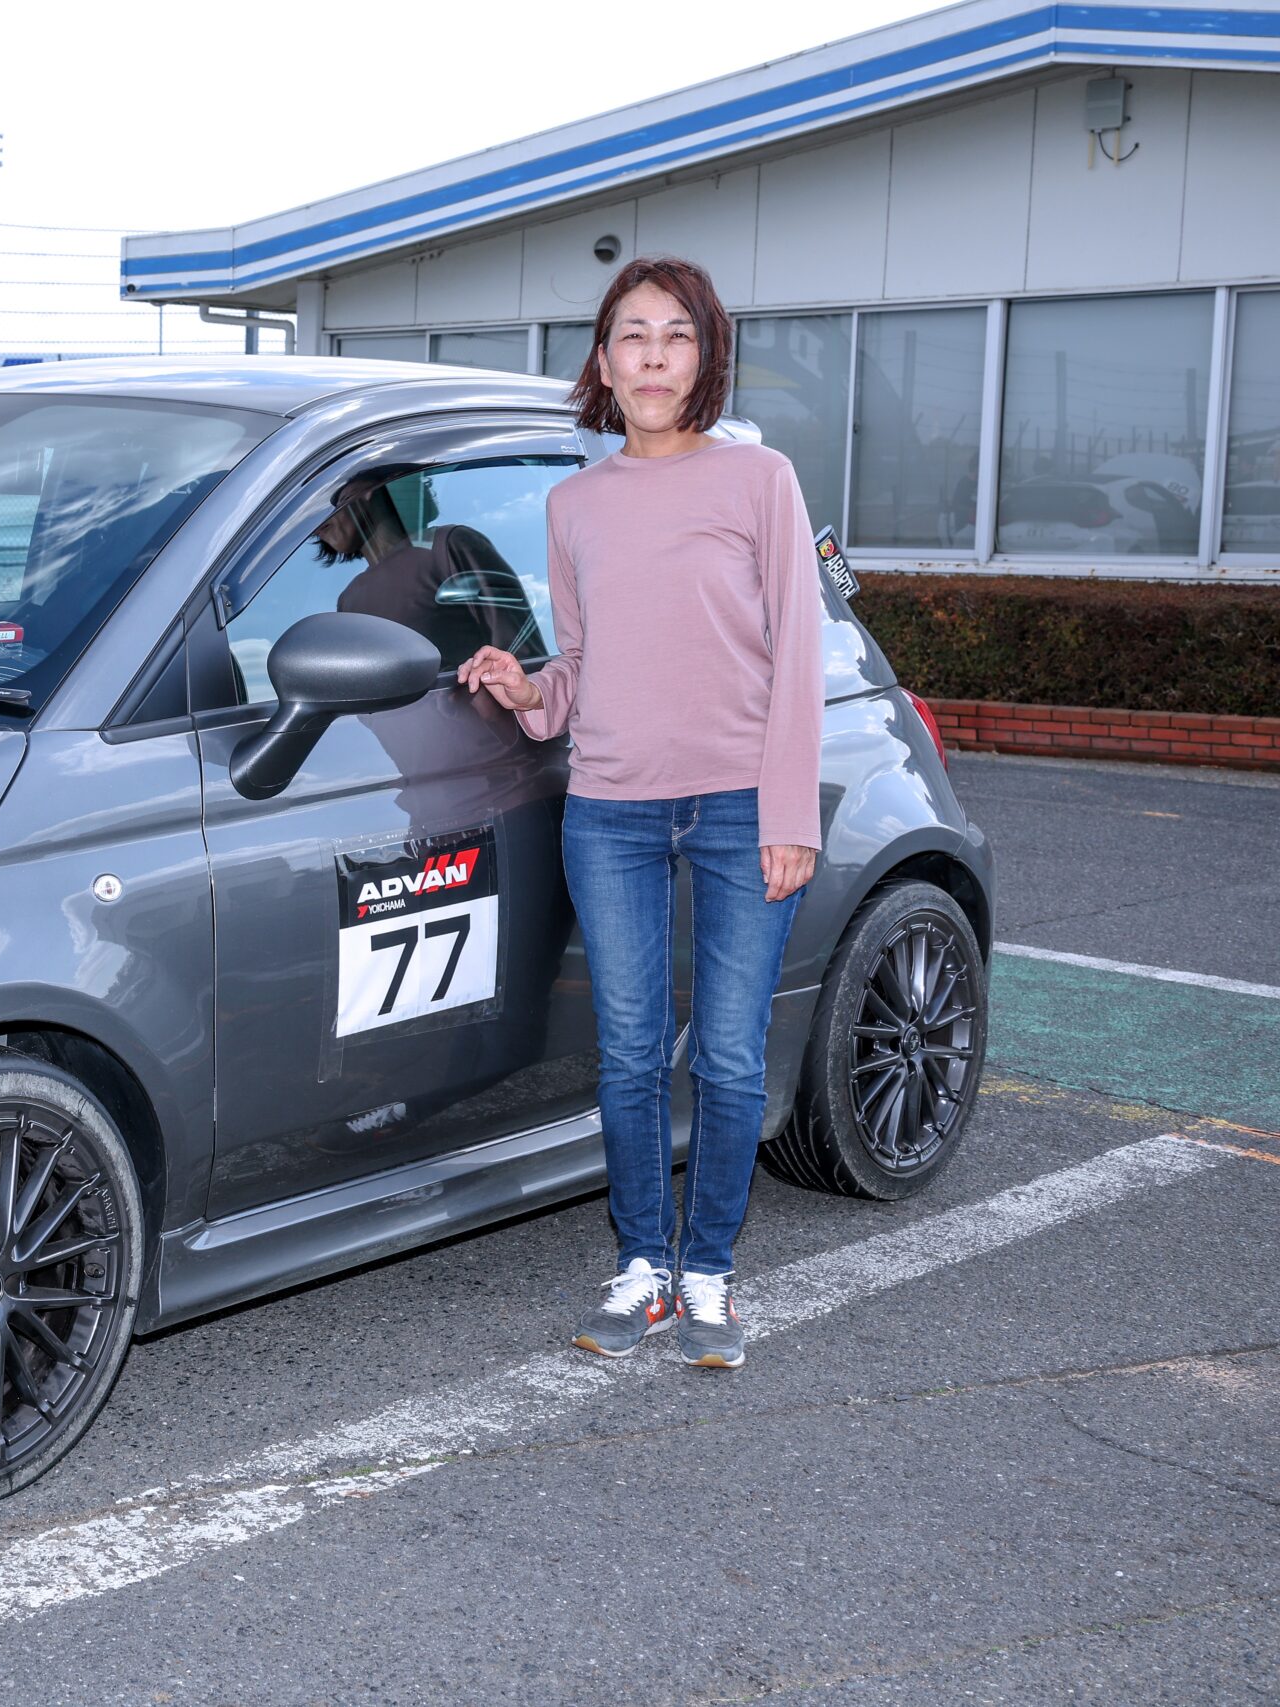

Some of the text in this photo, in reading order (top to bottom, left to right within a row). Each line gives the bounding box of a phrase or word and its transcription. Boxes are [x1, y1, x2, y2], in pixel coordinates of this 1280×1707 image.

[824, 553, 856, 599] ABARTH
[357, 863, 467, 904] ADVAN
[368, 898, 406, 914] YOKOHAMA
[370, 913, 471, 1016] 77
